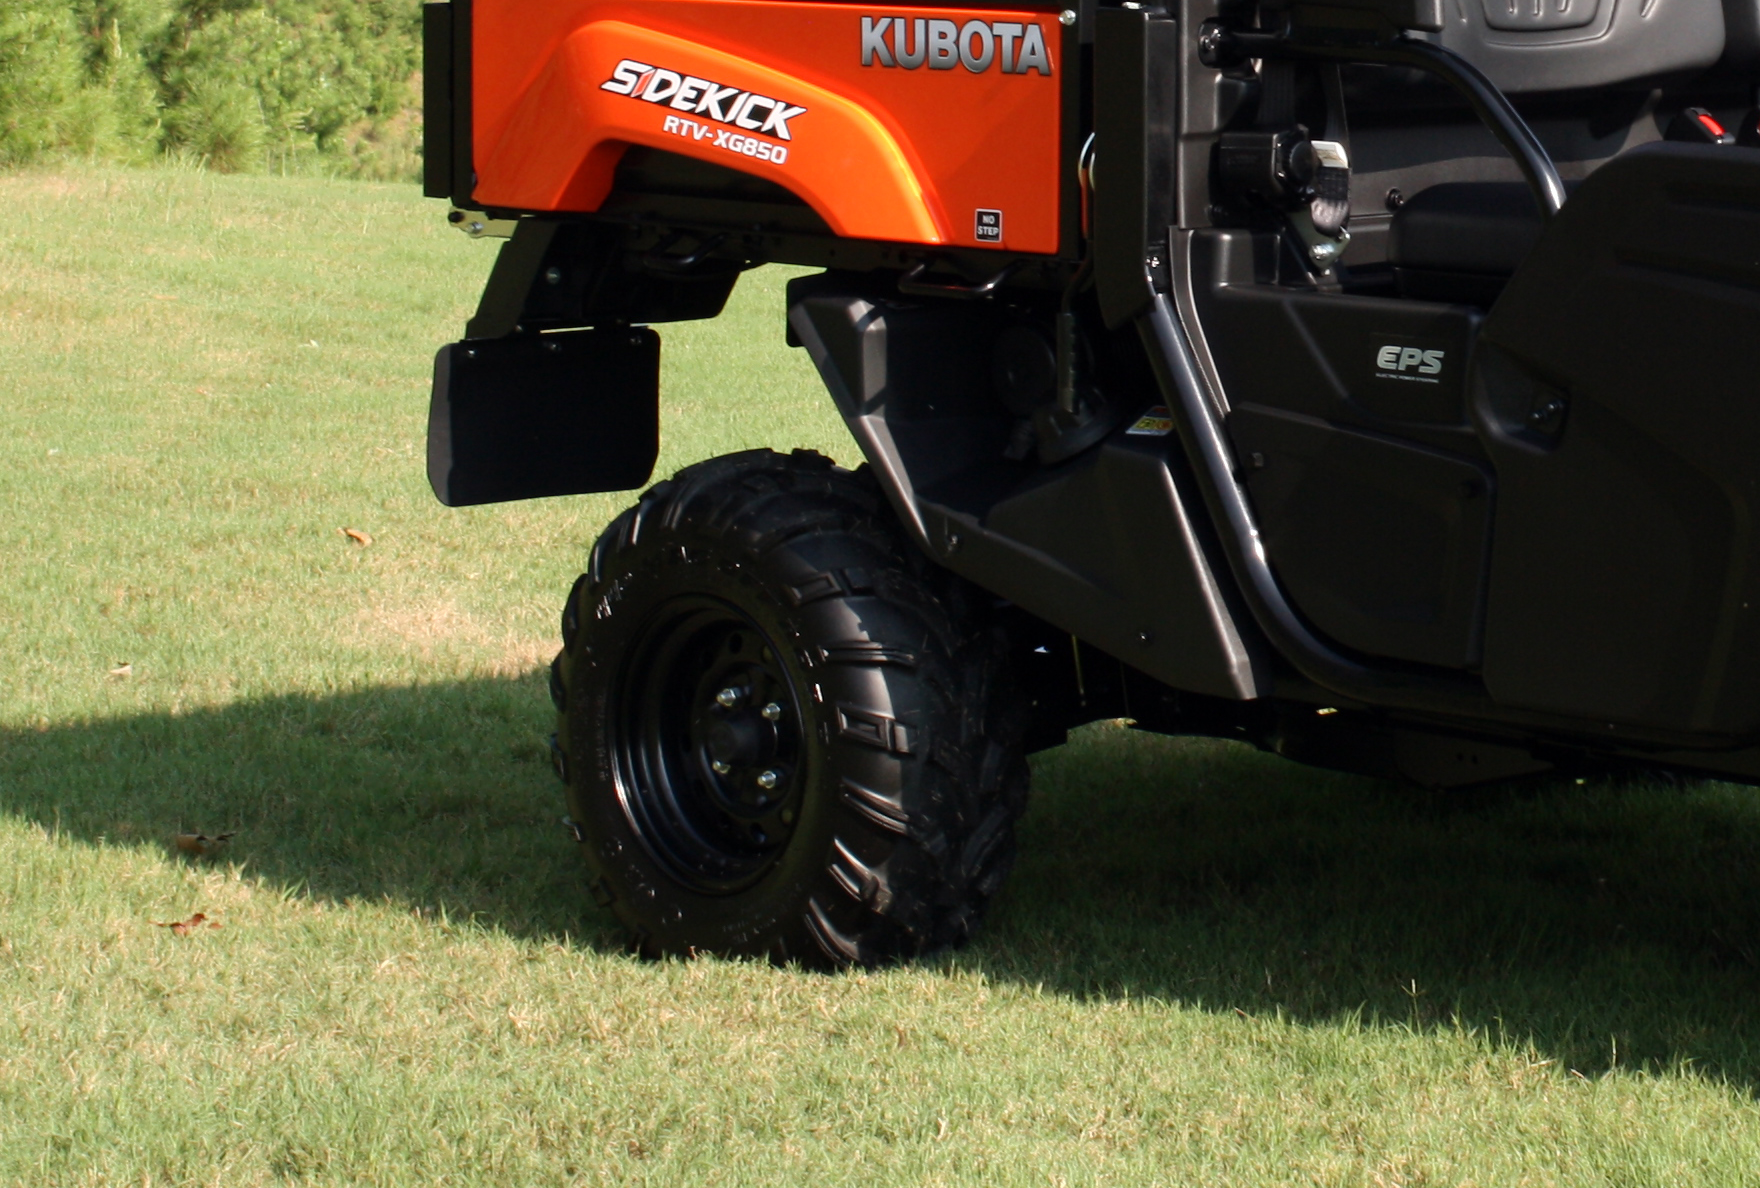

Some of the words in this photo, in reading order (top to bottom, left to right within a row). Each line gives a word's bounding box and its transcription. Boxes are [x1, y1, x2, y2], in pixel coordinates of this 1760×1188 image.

[861, 16, 1051, 75] KUBOTA
[600, 59, 807, 141] SIDEKICK
[662, 115, 788, 165] RTV-XG850
[977, 225, 999, 236] STEP
[982, 214, 995, 224] NO
[1376, 345, 1445, 374] EPS
